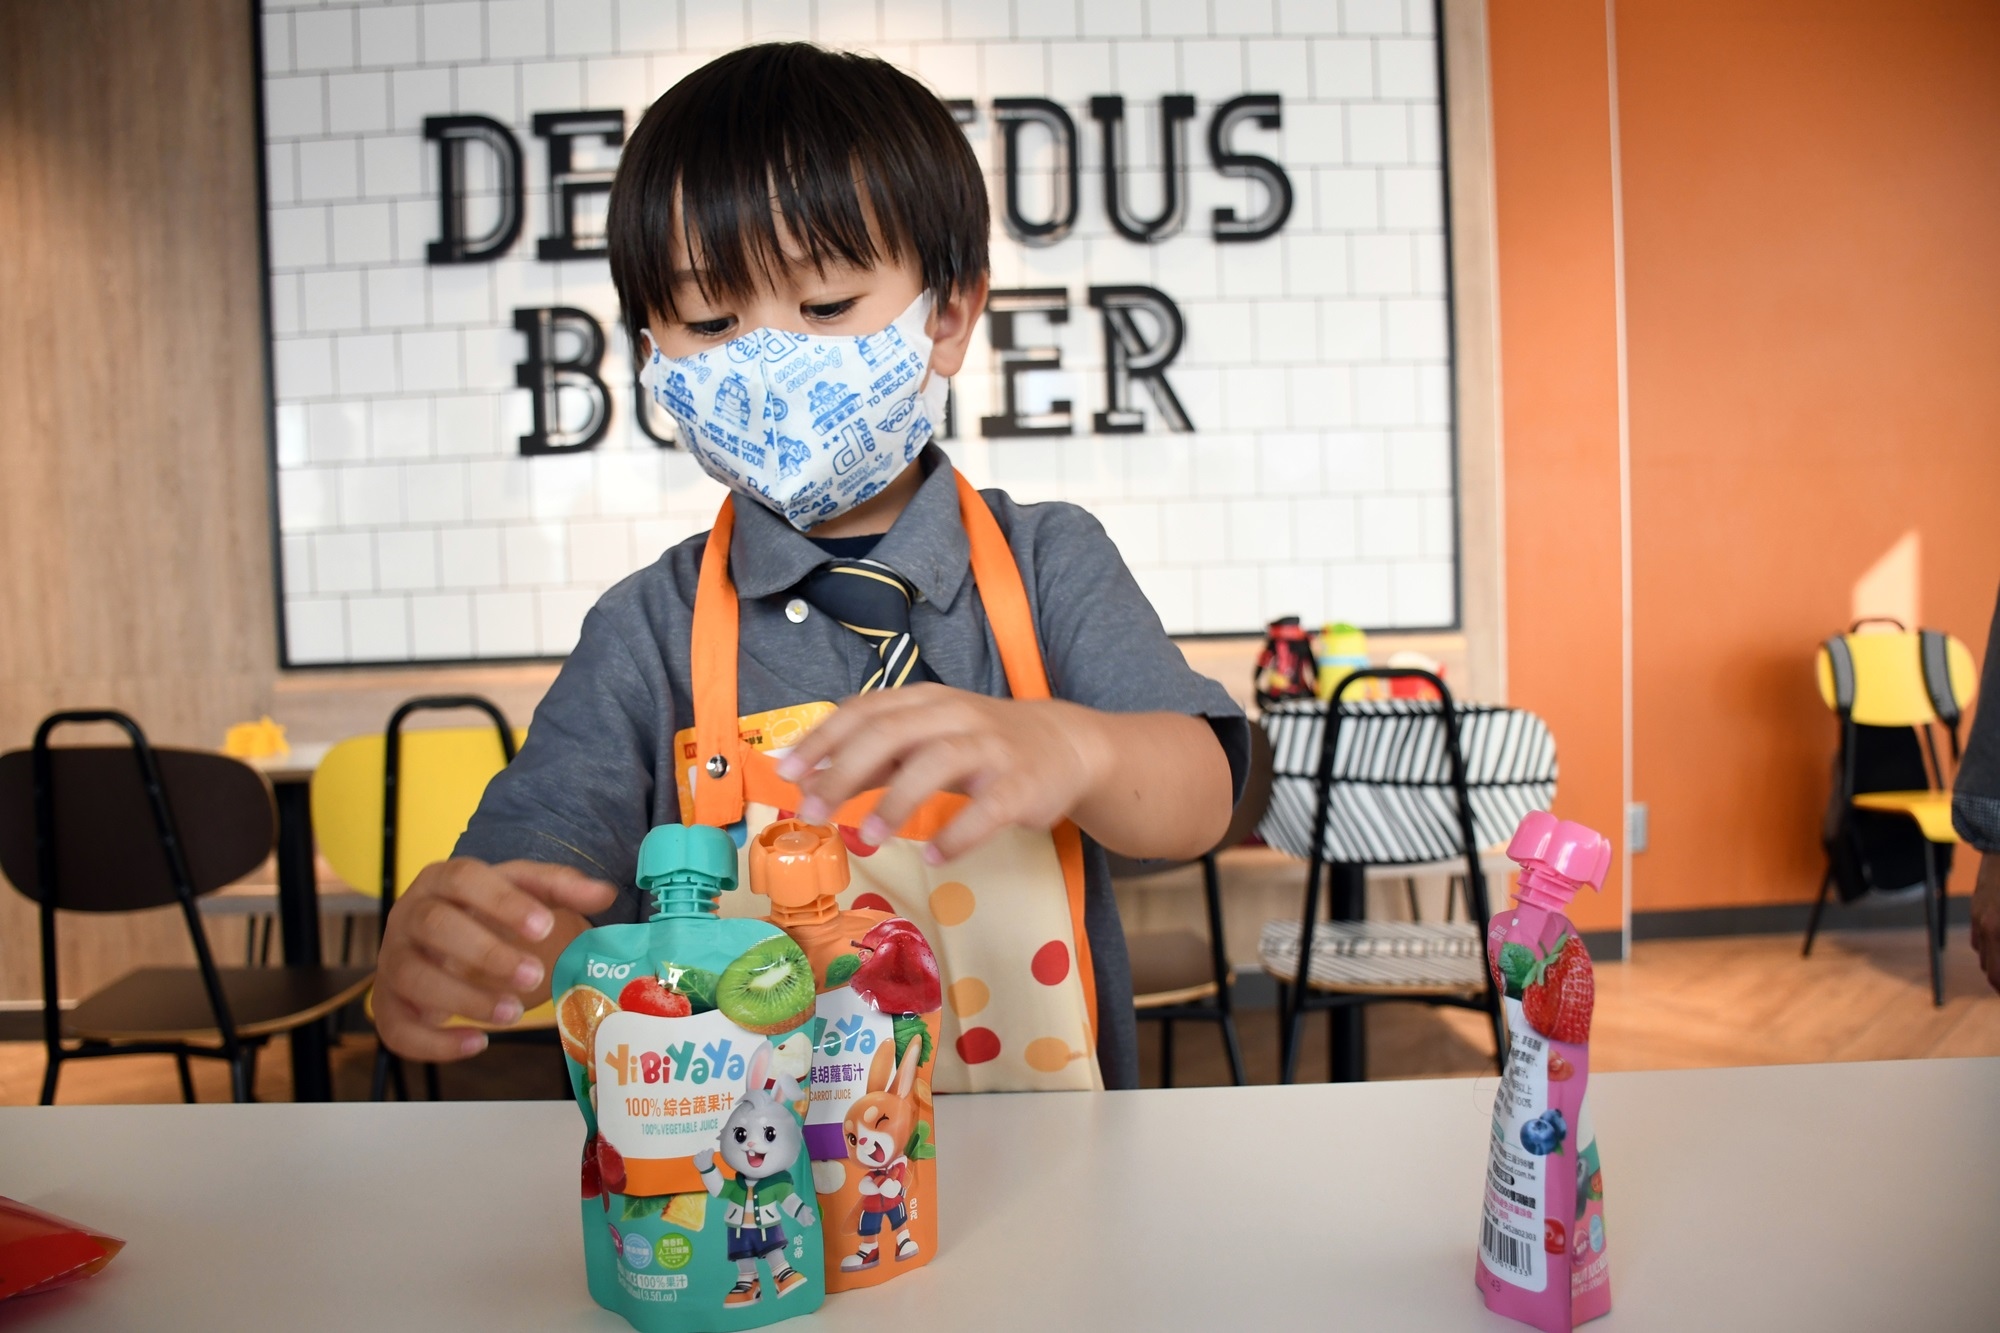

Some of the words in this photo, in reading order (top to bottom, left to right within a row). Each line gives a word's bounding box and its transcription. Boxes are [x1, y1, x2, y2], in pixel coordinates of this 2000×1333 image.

[424, 93, 1293, 264] DEOUS
[514, 285, 1196, 455] BER
[867, 395, 880, 408] TO
[881, 368, 916, 398] RESCUE
[870, 371, 893, 393] HERE
[893, 359, 909, 374] WE
[705, 420, 724, 438] HERE
[727, 432, 740, 446] WE
[742, 440, 766, 458] COME
[854, 417, 876, 452] SPEED
[605, 1038, 745, 1086] YiBiYaYa
[626, 1097, 661, 1117] 100%
[663, 1092, 734, 1117] 綜合蔬果汁
[810, 1090, 833, 1101] CARROT
[834, 1089, 852, 1100] JUICE
[642, 1123, 660, 1136] 100%
[660, 1121, 698, 1135] VEGETABLE
[699, 1118, 719, 1131] JUICE
